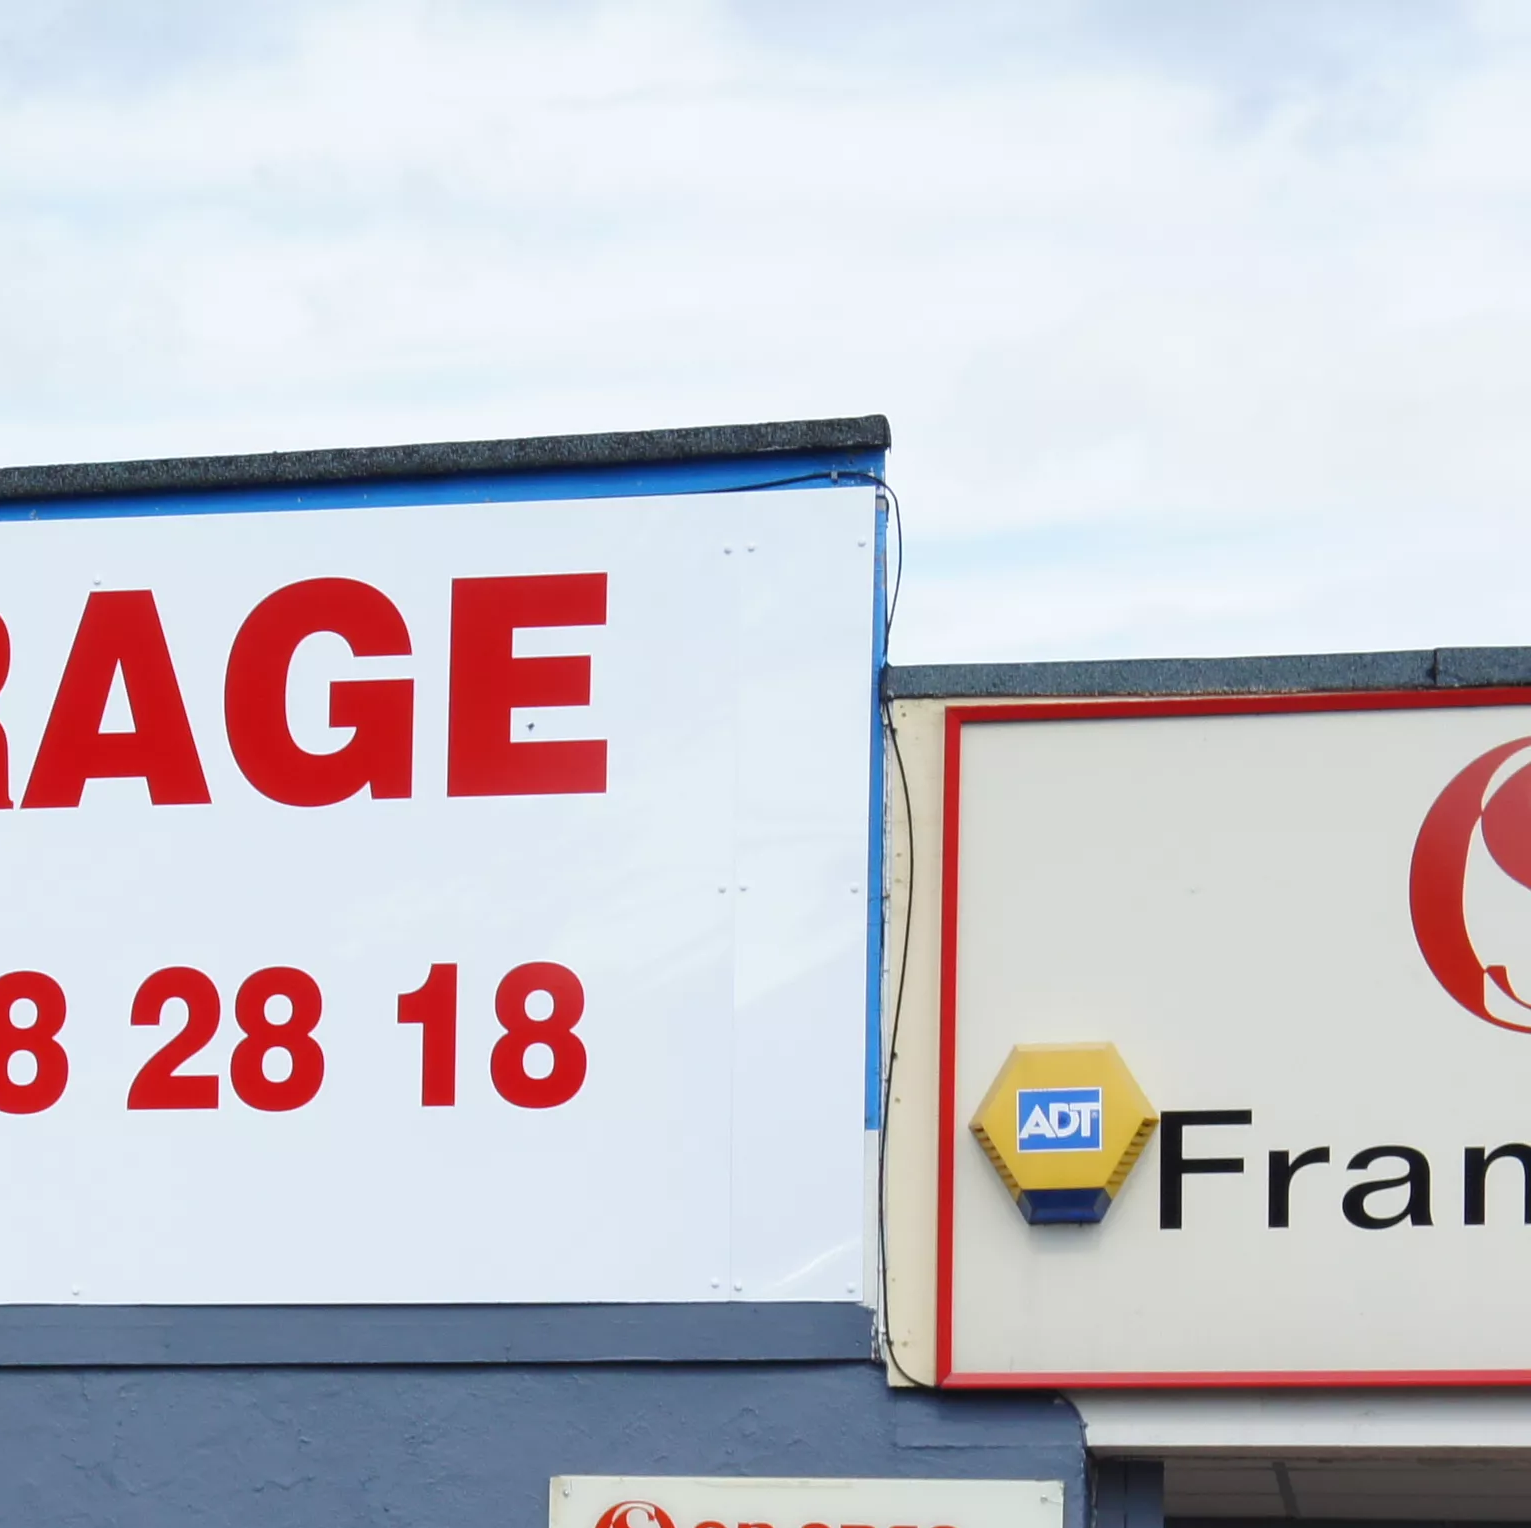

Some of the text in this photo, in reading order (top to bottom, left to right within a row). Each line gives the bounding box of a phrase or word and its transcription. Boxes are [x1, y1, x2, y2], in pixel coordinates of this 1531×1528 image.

[128, 967, 325, 1111] 28
[398, 962, 587, 1108] 18
[1019, 1102, 1100, 1139] ADT
